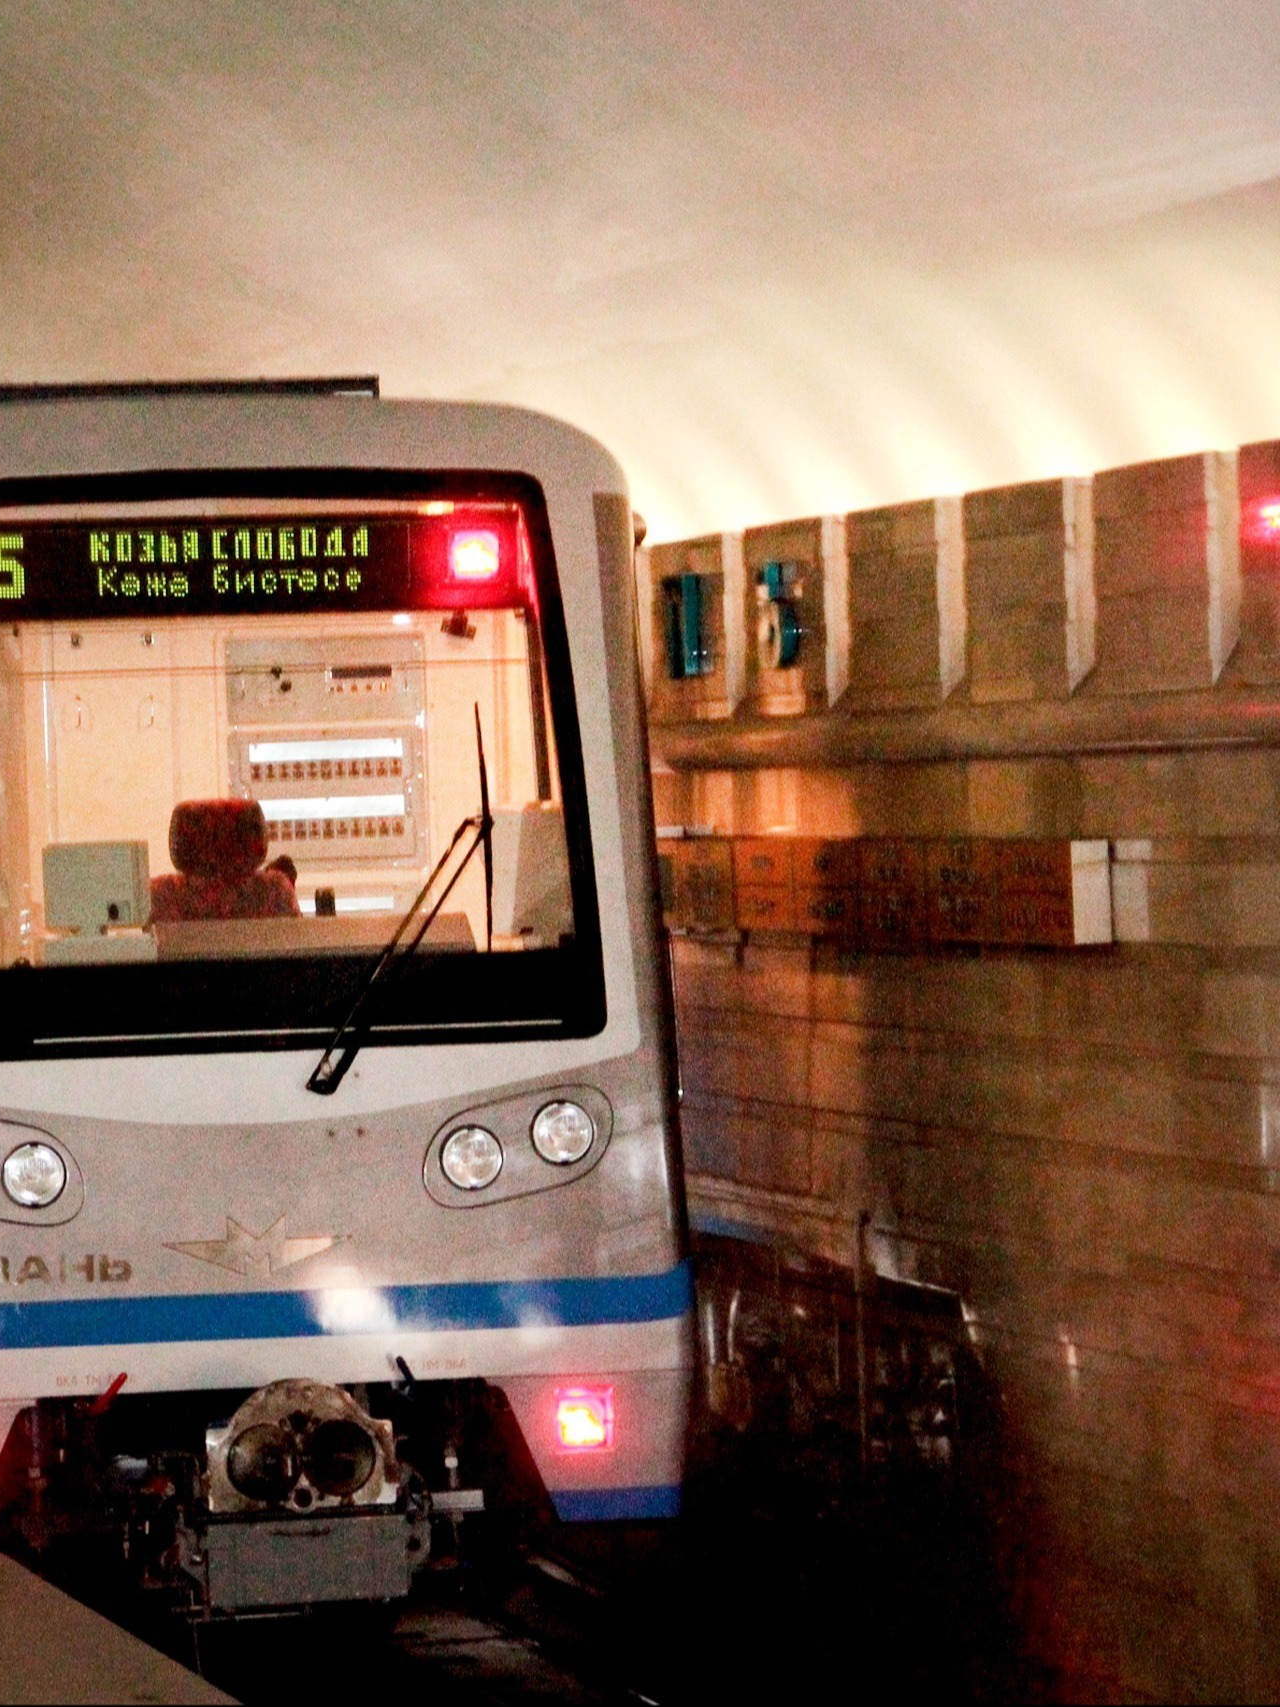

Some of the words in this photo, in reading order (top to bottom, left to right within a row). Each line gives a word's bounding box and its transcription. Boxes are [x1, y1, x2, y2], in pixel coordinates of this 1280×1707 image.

[89, 529, 199, 563] КОЗЬЯ
[212, 525, 369, 561] СЛОБОДА
[98, 565, 189, 598] Кәжә
